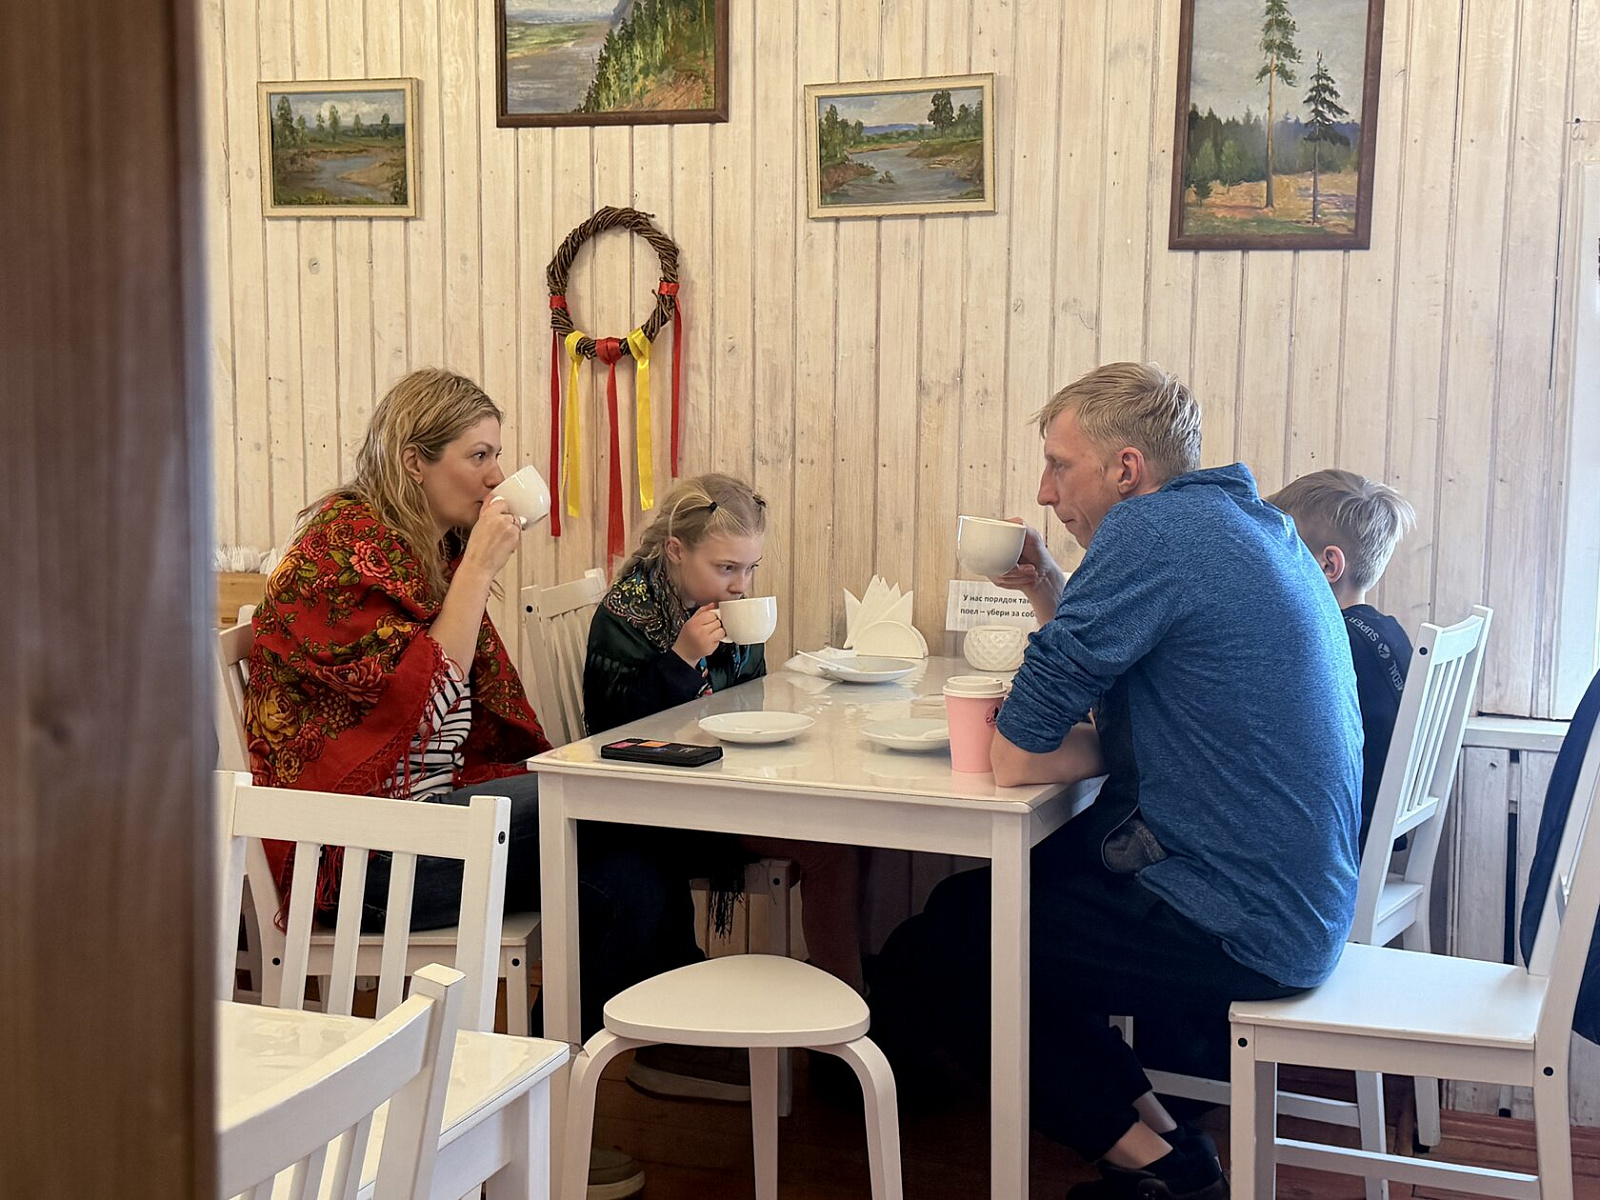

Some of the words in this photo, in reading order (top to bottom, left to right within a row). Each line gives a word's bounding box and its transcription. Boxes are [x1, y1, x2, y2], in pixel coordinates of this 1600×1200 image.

[984, 596, 1017, 604] порядок
[986, 608, 1010, 617] убери
[1021, 609, 1036, 618] соб
